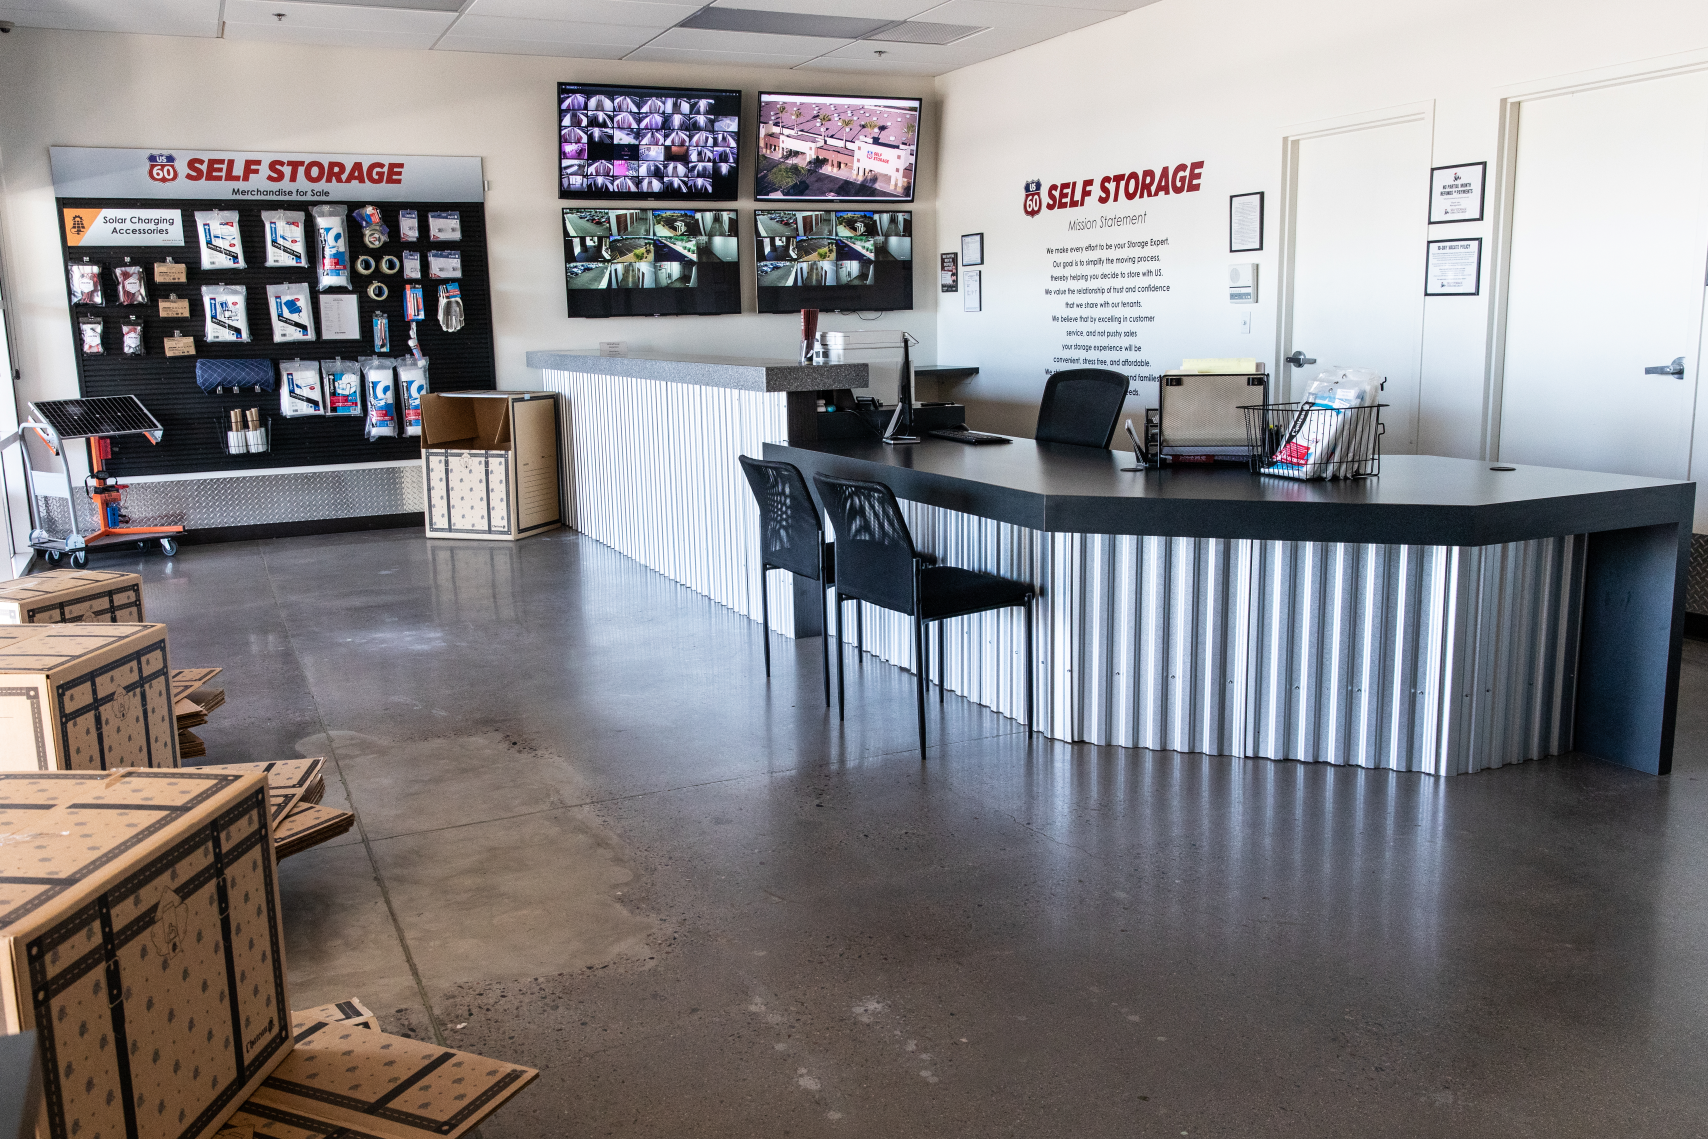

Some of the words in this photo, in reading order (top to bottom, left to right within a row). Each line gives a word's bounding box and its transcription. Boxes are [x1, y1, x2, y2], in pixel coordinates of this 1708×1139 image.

[156, 155, 167, 163] US
[152, 165, 175, 179] 60
[185, 157, 262, 182] SELF
[266, 159, 405, 184] STORAGE
[1029, 182, 1037, 191] US
[1045, 178, 1095, 211] SELF
[1097, 160, 1205, 205] STORAGE
[231, 188, 293, 197] Merchandise
[295, 188, 309, 197] for
[310, 188, 330, 197] Sale
[1026, 194, 1040, 212] 60
[103, 215, 127, 224] Solar
[129, 216, 175, 226] Charging
[1067, 217, 1097, 232] Mission
[1099, 210, 1148, 229] Statement
[111, 226, 169, 235] Accessories
[1046, 247, 1054, 255] We
[1054, 246, 1069, 254] make
[1069, 245, 1084, 254] every
[1084, 243, 1098, 252] effort
[1105, 242, 1113, 251] be
[1113, 242, 1127, 251] your
[1127, 239, 1149, 250] Storage
[1150, 237, 1170, 246] Expert.
[1052, 260, 1062, 268] Our
[1062, 259, 1074, 270] goal
[1079, 259, 1085, 267] to
[1085, 257, 1105, 267] simplify
[1105, 256, 1115, 265] the
[1115, 255, 1136, 265] moving
[1136, 254, 1161, 264] process,
[1050, 274, 1069, 282] thereby
[1069, 272, 1089, 282] helping
[1089, 273, 1100, 281] you
[1100, 271, 1120, 280] decide
[1120, 270, 1127, 279] to
[1126, 269, 1141, 279] store
[1141, 269, 1154, 277] with
[1154, 268, 1164, 277] US.
[1044, 288, 1053, 296] We
[1053, 287, 1067, 296] value
[1067, 287, 1076, 295] the
[1076, 286, 1106, 296] relationship
[1106, 286, 1113, 294] of
[1112, 285, 1125, 294] trust
[1124, 284, 1137, 293] and
[1137, 283, 1171, 292] confidence
[1065, 301, 1075, 309] that
[1084, 301, 1099, 309] share
[1099, 300, 1111, 309] with
[1121, 300, 1143, 308] tenants.
[1051, 315, 1060, 323] We
[1060, 315, 1079, 323] believe
[1079, 315, 1091, 323] that
[1090, 315, 1097, 325] by
[1097, 315, 1122, 325] excelling
[1122, 315, 1129, 323] in
[1128, 315, 1156, 323] customer
[1066, 329, 1085, 337] service,
[1096, 330, 1107, 338] not
[1106, 330, 1123, 339] pushy
[1123, 330, 1138, 338] sales
[1073, 343, 1093, 353] storage
[1093, 344, 1123, 353] experience
[1123, 344, 1134, 352] will
[1082, 358, 1097, 366] stress
[1096, 358, 1109, 367] free,
[1109, 359, 1121, 367] and
[1121, 359, 1152, 368] affordable.
